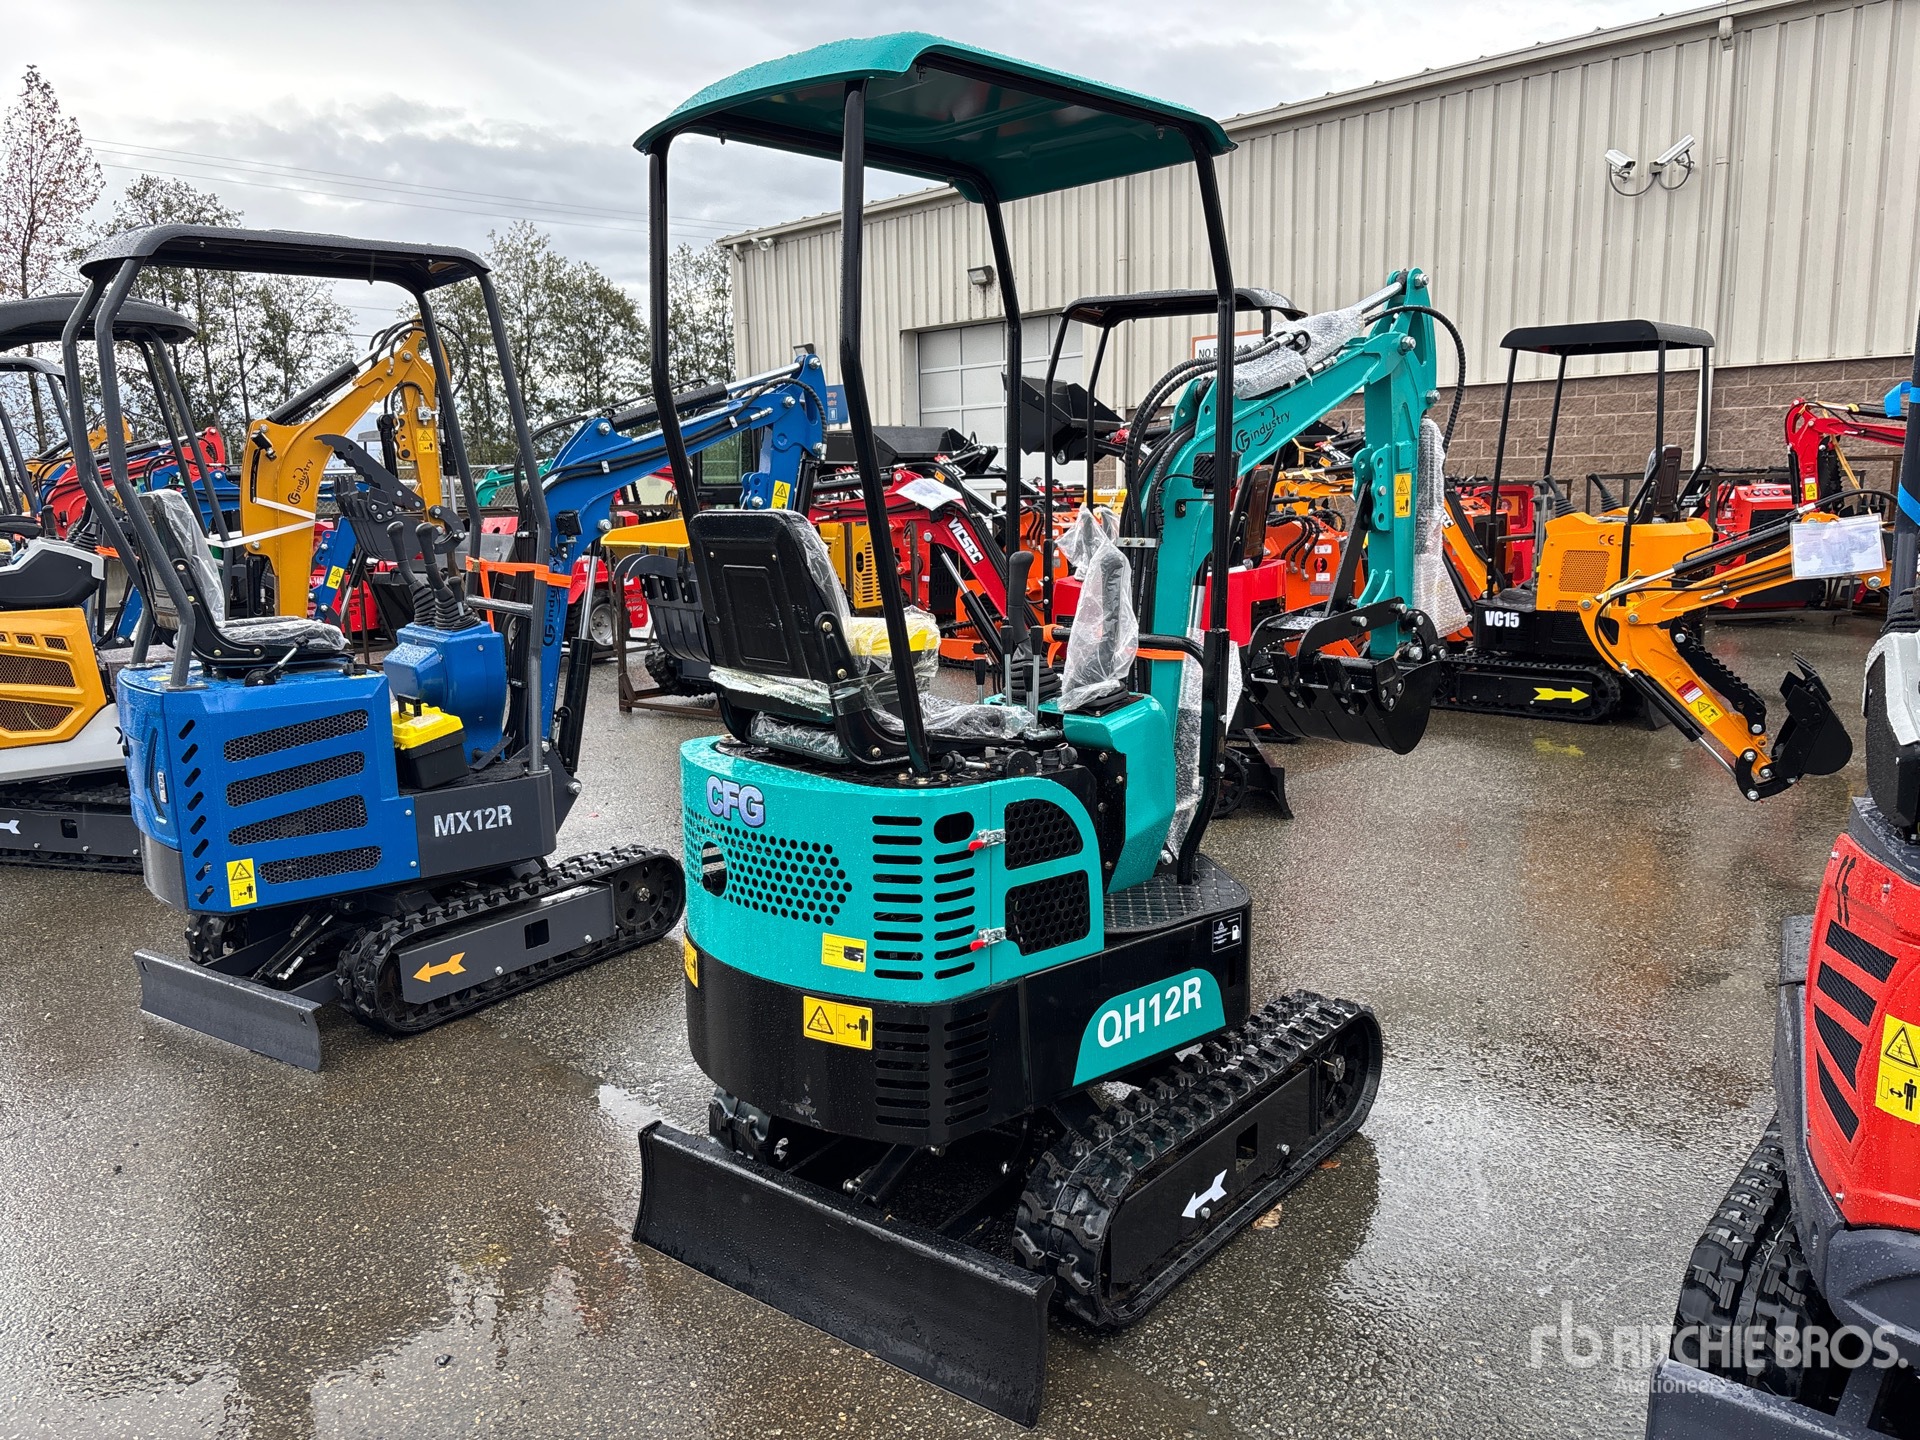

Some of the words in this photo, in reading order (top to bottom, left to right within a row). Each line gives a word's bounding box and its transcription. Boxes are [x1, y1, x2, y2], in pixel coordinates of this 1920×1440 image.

[948, 516, 984, 565] VICSEC
[1485, 611, 1520, 628] VC15
[433, 804, 513, 838] MX12R
[706, 774, 766, 828] CFG
[1097, 976, 1202, 1048] QH12R
